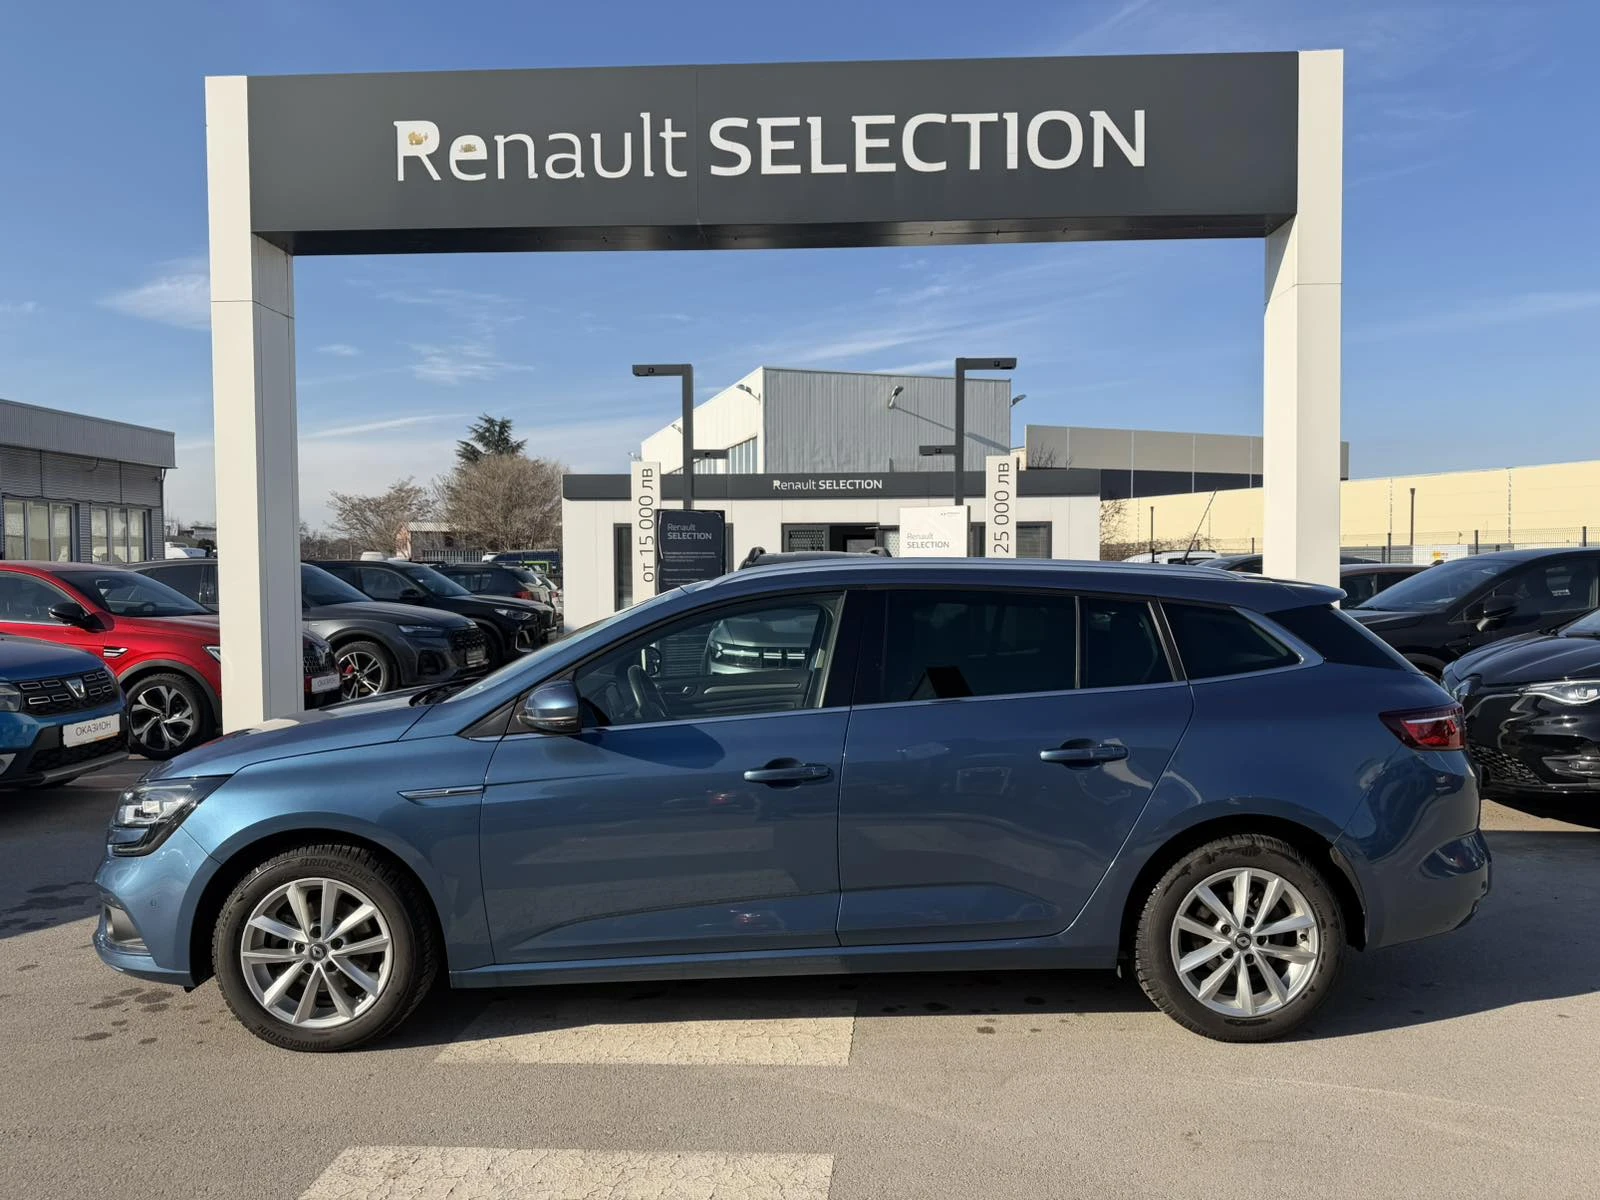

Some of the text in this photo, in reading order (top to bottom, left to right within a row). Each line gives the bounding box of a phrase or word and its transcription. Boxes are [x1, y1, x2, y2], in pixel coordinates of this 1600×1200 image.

[393, 109, 1146, 182] Renault SELECTION
[772, 479, 883, 490] Renault SELECTION
[638, 495, 654, 530] 000
[993, 490, 1010, 526] 000
[667, 523, 696, 531] Renault
[667, 532, 712, 540] SELECTION
[906, 532, 934, 540] Renault
[993, 531, 1010, 553] 25
[639, 535, 654, 557] 15
[906, 541, 950, 549] SELECTION
[75, 721, 112, 737] ОКАЗИОН
